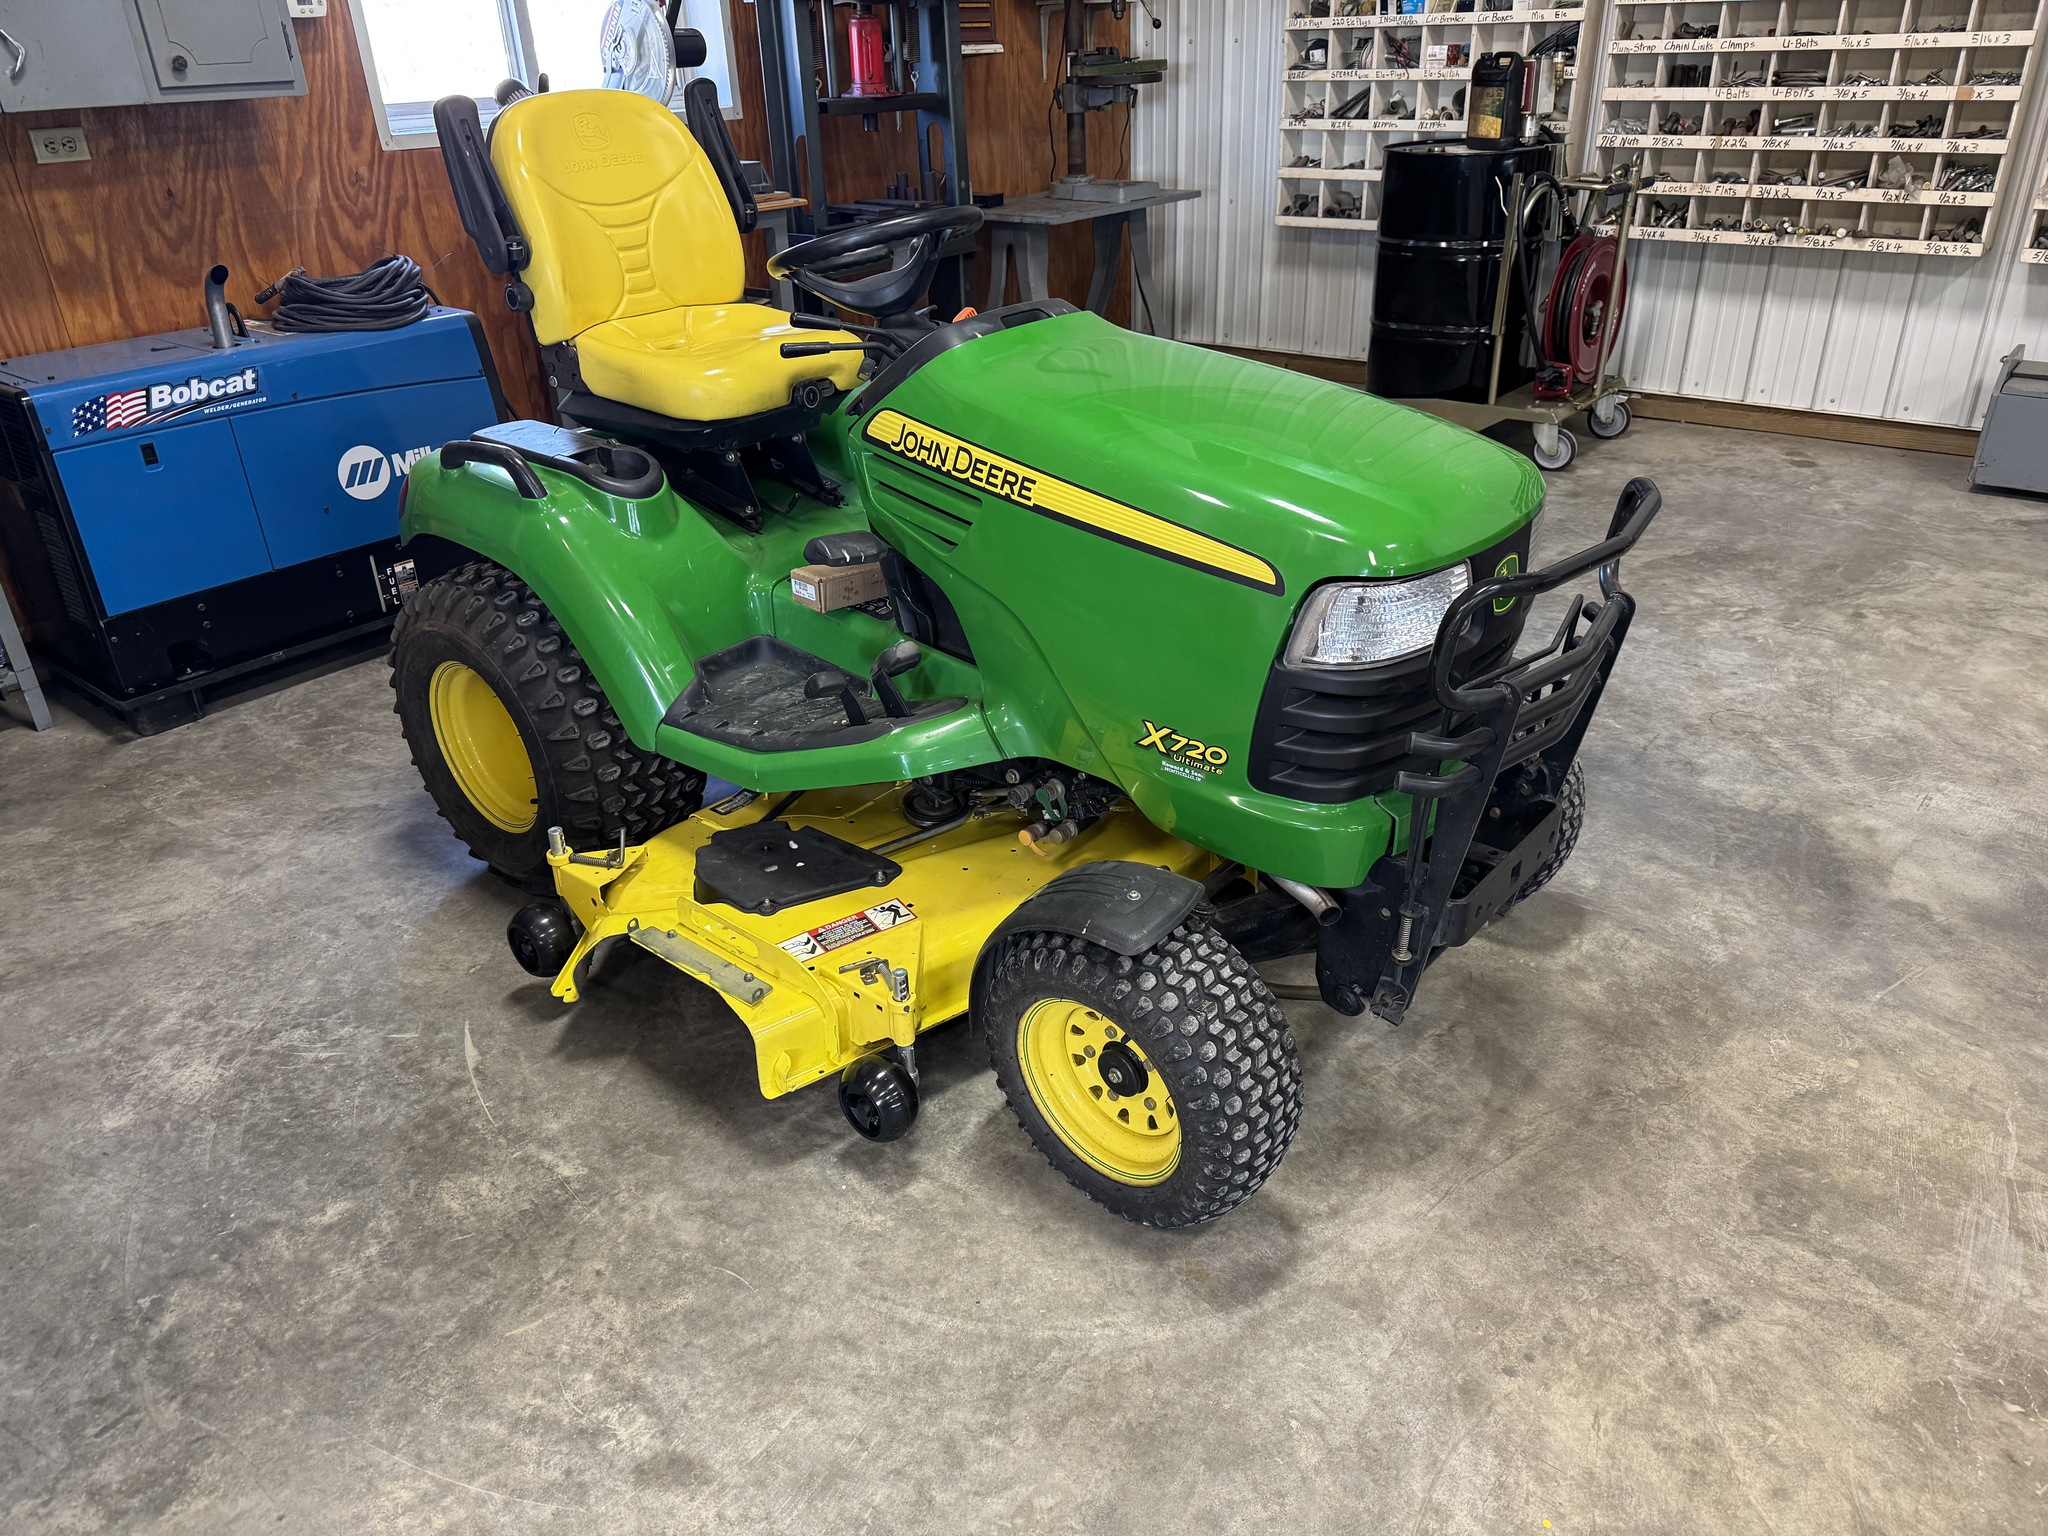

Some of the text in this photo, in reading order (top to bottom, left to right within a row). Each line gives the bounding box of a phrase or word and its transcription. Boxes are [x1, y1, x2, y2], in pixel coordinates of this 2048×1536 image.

[1332, 18, 1345, 26] 220
[1491, 12, 1514, 22] Boxes
[1782, 38, 1819, 49] U-Bolts
[1288, 71, 1306, 80] WIRE
[1331, 70, 1358, 78] SPEAKER
[1715, 88, 1750, 99] U-Bolts
[1772, 88, 1815, 98] U-Bolts
[1985, 89, 1995, 98] 3
[1330, 120, 1352, 128] WIRE
[1619, 136, 1639, 146] Nuts
[564, 152, 644, 175] JOHN DEERE
[1662, 185, 1687, 194] Locks
[1698, 185, 1711, 195] 3/4
[151, 368, 257, 410] Bobcat
[203, 397, 267, 415] WELDER/GENERATOR
[891, 423, 1037, 503] JOHN DEERE
[386, 567, 400, 605] FUEL
[1136, 719, 1229, 766] X720
[1173, 754, 1224, 776] Ultimate
[825, 915, 857, 930] DANGER
